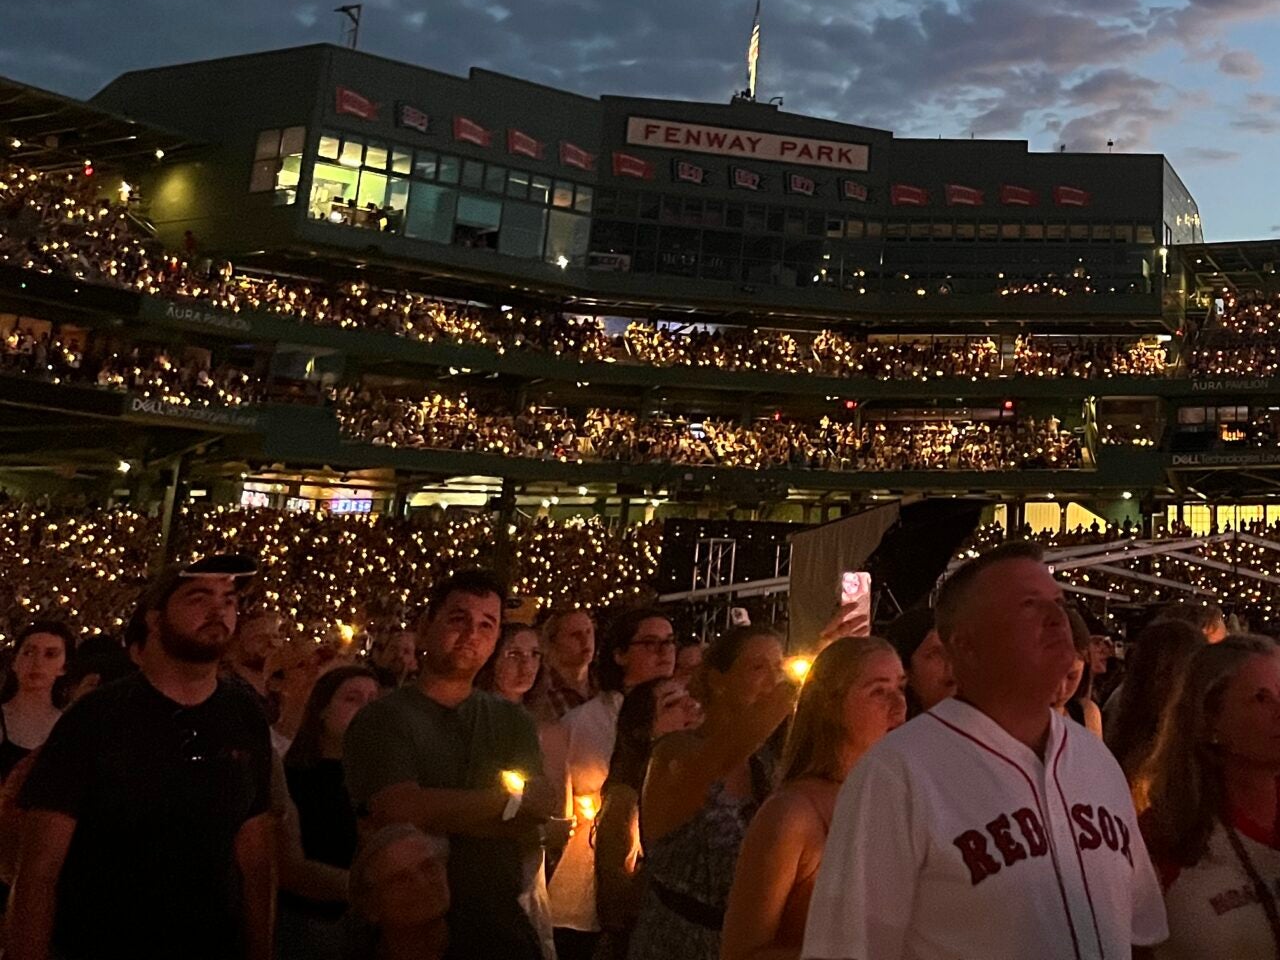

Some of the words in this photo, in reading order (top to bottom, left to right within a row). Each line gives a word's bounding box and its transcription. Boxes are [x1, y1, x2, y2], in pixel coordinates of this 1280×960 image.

[644, 124, 762, 153] FENWAY
[780, 141, 853, 165] PARK
[132, 398, 164, 414] DELL
[1172, 455, 1200, 465] DELL
[1201, 454, 1260, 465] Technologies
[953, 807, 1048, 886] RED
